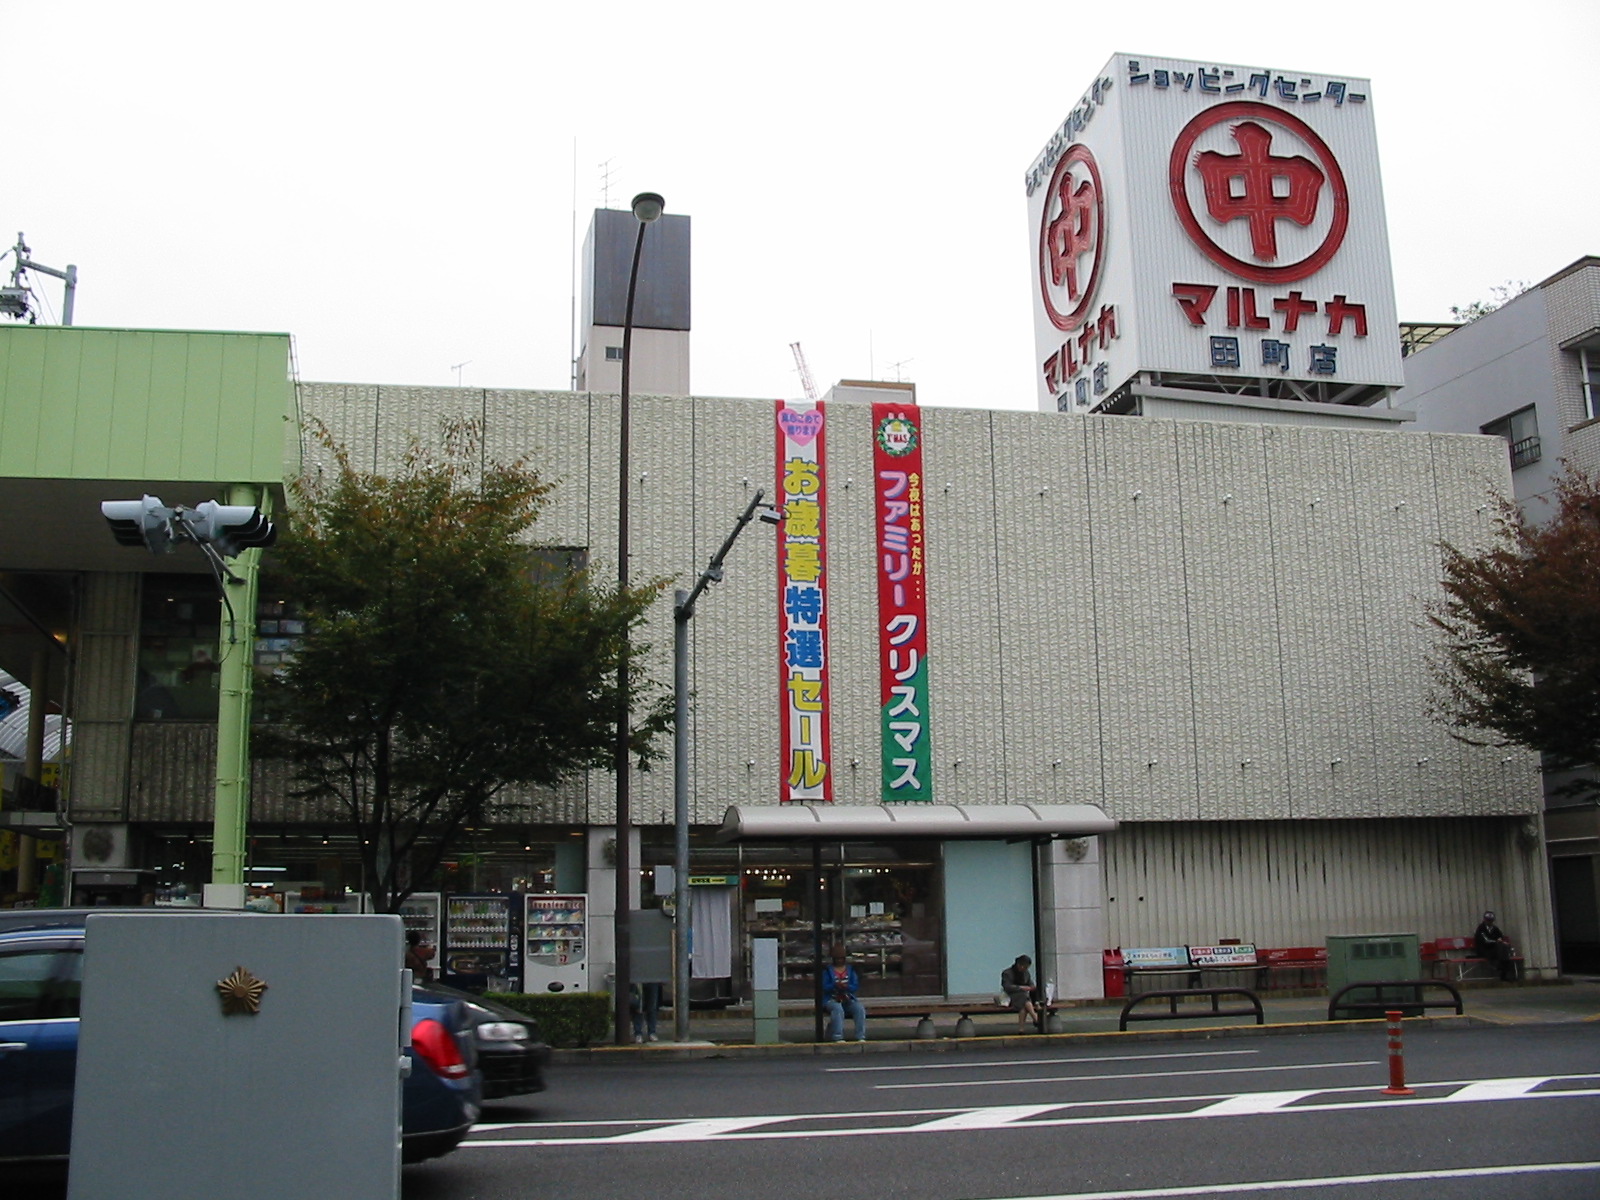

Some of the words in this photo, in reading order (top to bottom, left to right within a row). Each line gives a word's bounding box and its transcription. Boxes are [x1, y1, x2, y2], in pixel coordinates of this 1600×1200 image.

[1127, 60, 1367, 107] ショッピングセンター
[1192, 121, 1326, 262] 中
[1171, 282, 1368, 339] マルナカ
[1043, 303, 1118, 395] マルナカ
[1208, 335, 1338, 375] 田町店
